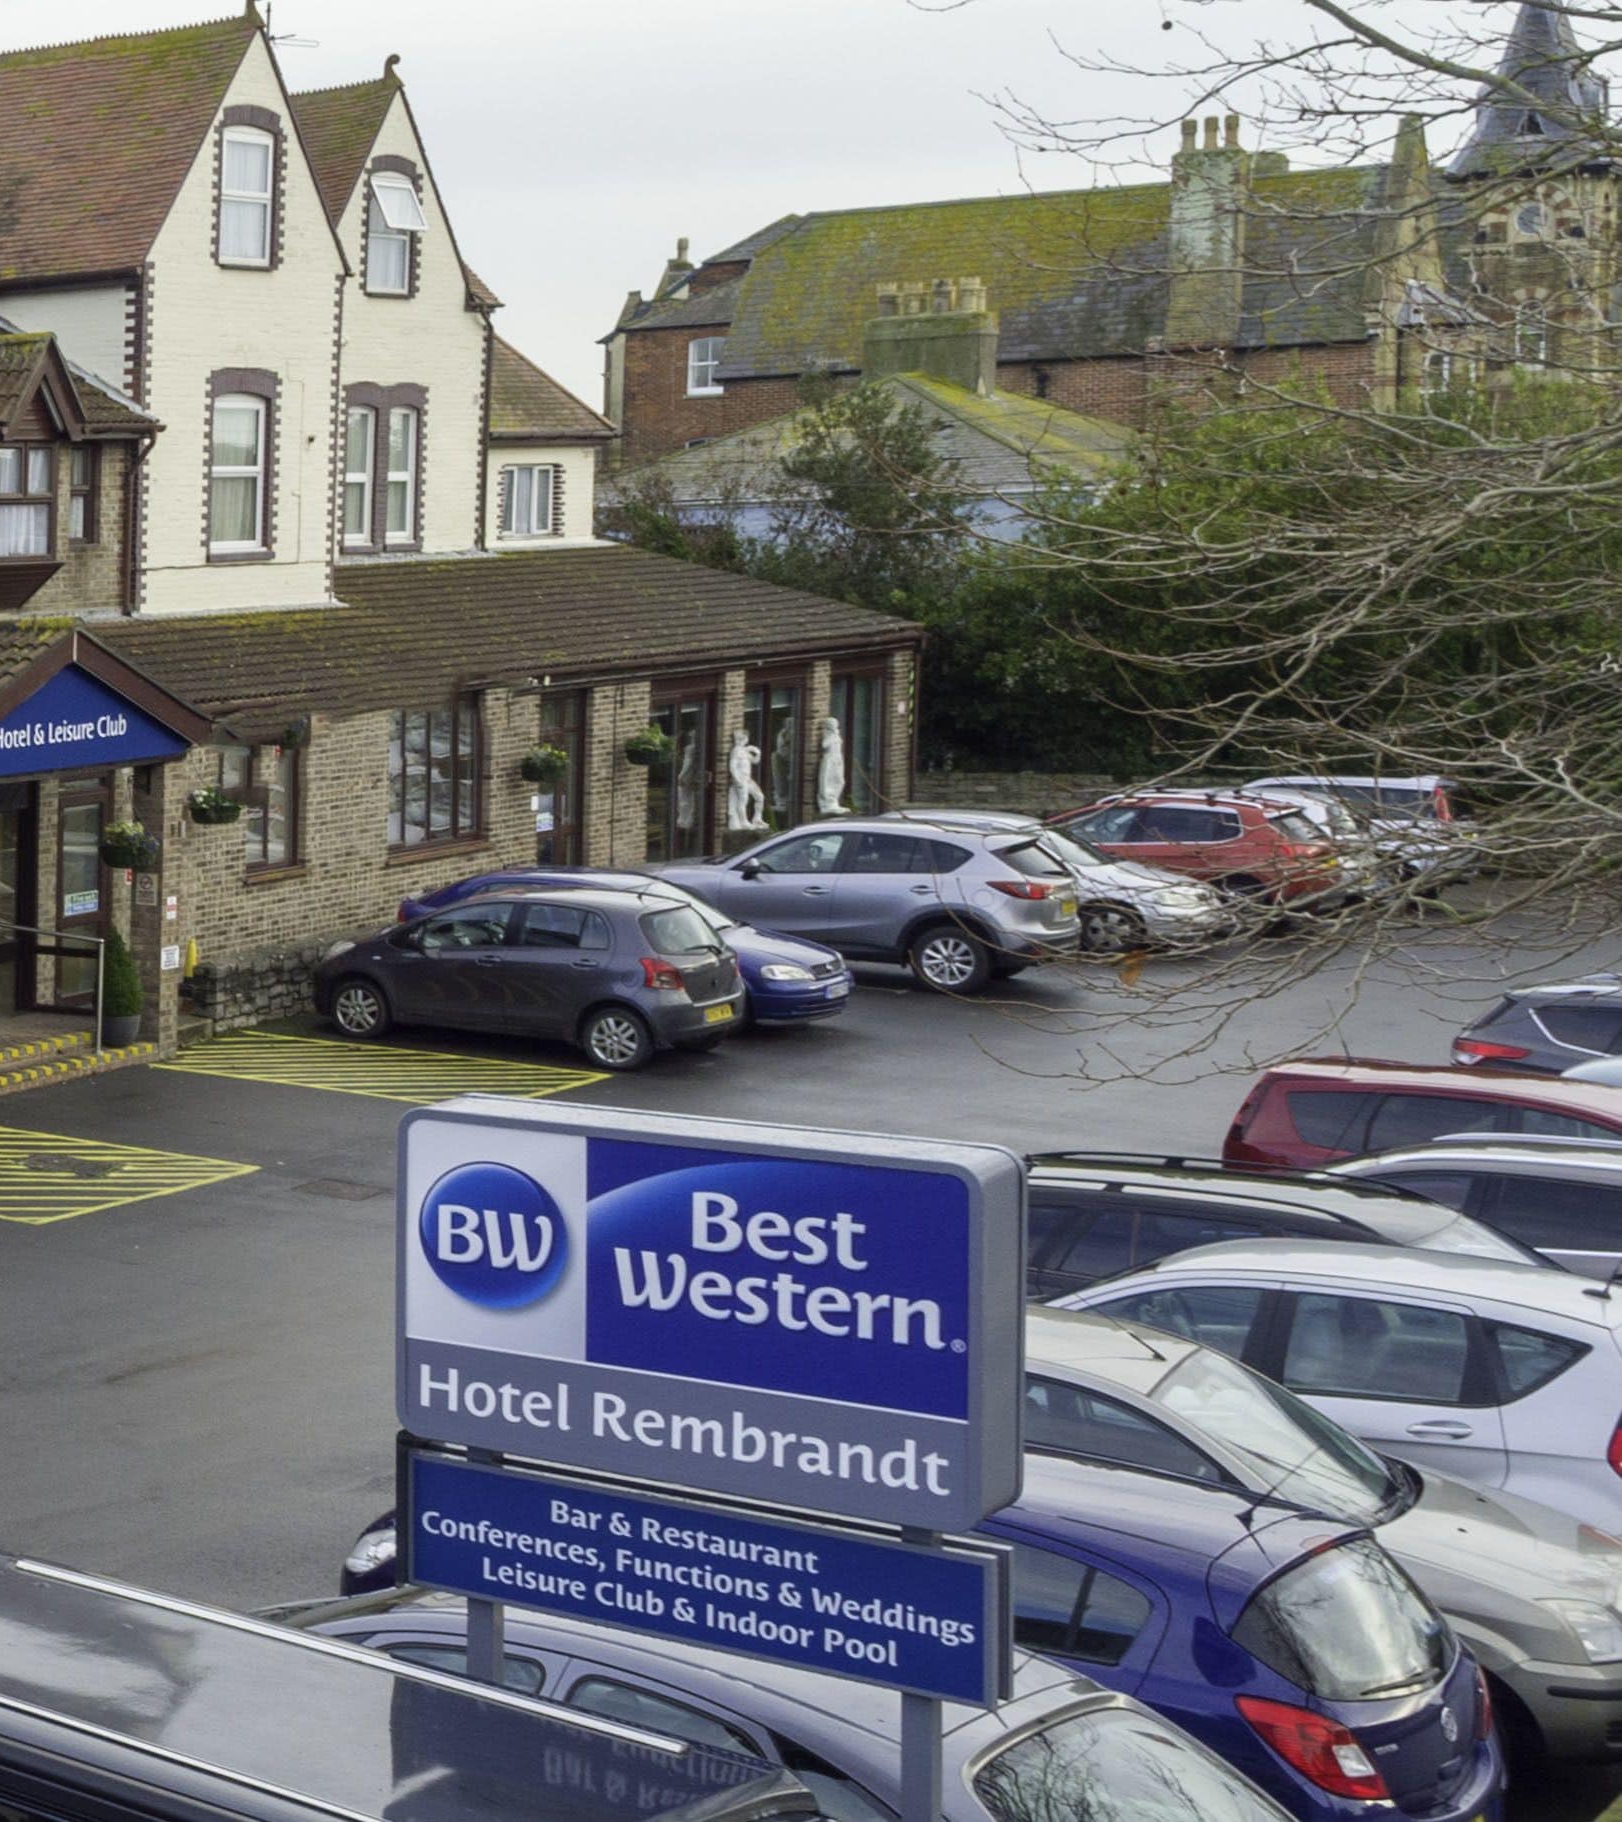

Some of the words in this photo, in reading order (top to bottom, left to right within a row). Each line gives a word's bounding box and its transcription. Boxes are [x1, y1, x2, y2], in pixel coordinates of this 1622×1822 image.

[34, 723, 45, 745] &
[49, 720, 94, 744] Leisure
[97, 714, 127, 738] Club
[436, 1203, 553, 1273] BW
[691, 1190, 869, 1272] Best
[419, 1363, 571, 1432] Hotel
[592, 1391, 951, 1496] Rembrandt
[550, 1499, 602, 1532] Bar
[609, 1510, 632, 1537] &
[641, 1518, 819, 1575] Restaurant
[421, 1510, 606, 1573] Conferences,
[616, 1548, 770, 1602] Functions
[778, 1581, 803, 1608] &
[811, 1586, 976, 1648] Weddings
[482, 1557, 587, 1601] Leisure
[594, 1580, 664, 1618] Club
[672, 1597, 697, 1624] &
[706, 1604, 814, 1651] Indoor
[824, 1628, 898, 1667] Pool
